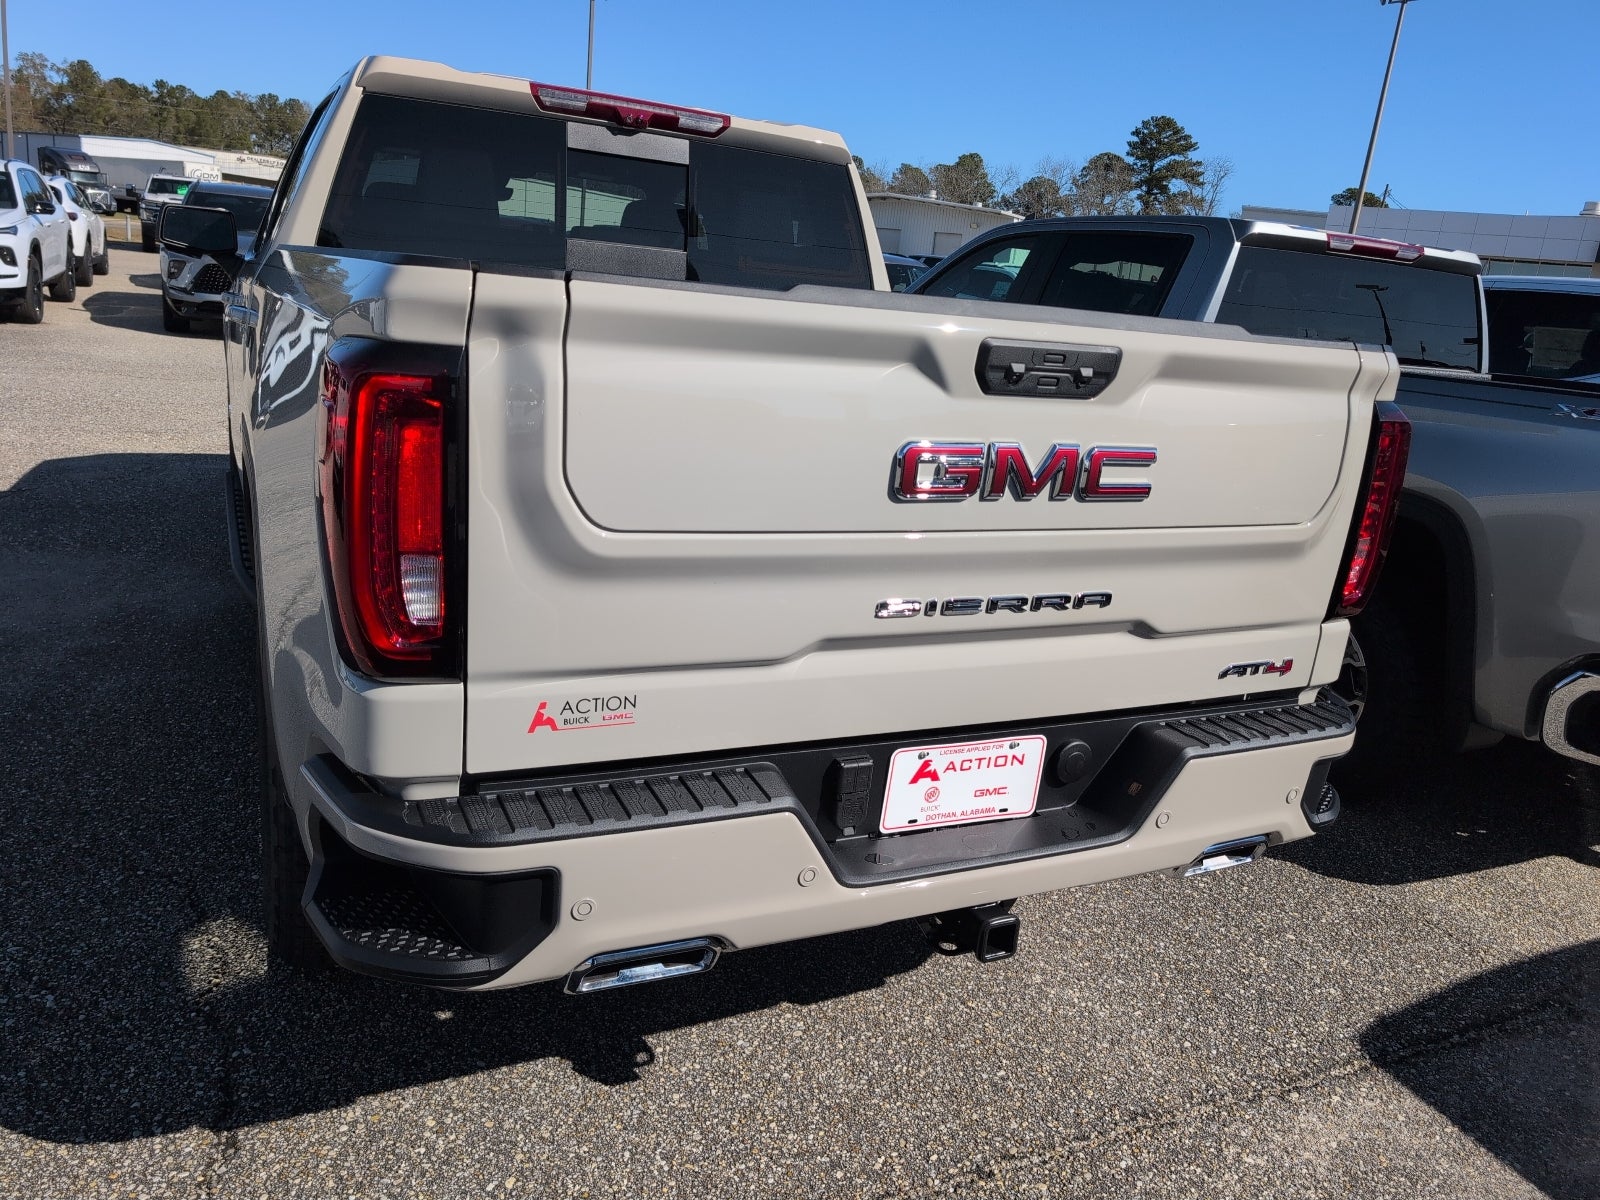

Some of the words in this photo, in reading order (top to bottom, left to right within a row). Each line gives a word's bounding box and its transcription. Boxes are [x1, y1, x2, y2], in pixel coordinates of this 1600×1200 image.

[892, 440, 1158, 502] GMC
[874, 590, 1113, 619] SIERRA
[1217, 657, 1294, 680] AT4
[559, 694, 637, 716] ACTION
[563, 716, 590, 726] BUICK
[602, 712, 634, 721] GMC
[939, 747, 966, 756] LICENSE
[966, 745, 991, 753] APPLIED
[992, 743, 1005, 751] FOR
[943, 753, 1026, 774] ACTION
[973, 786, 1008, 798] GMC
[920, 804, 940, 813] BUICK
[925, 811, 959, 822] DOTHAN,
[960, 806, 996, 818] ALABAMA
